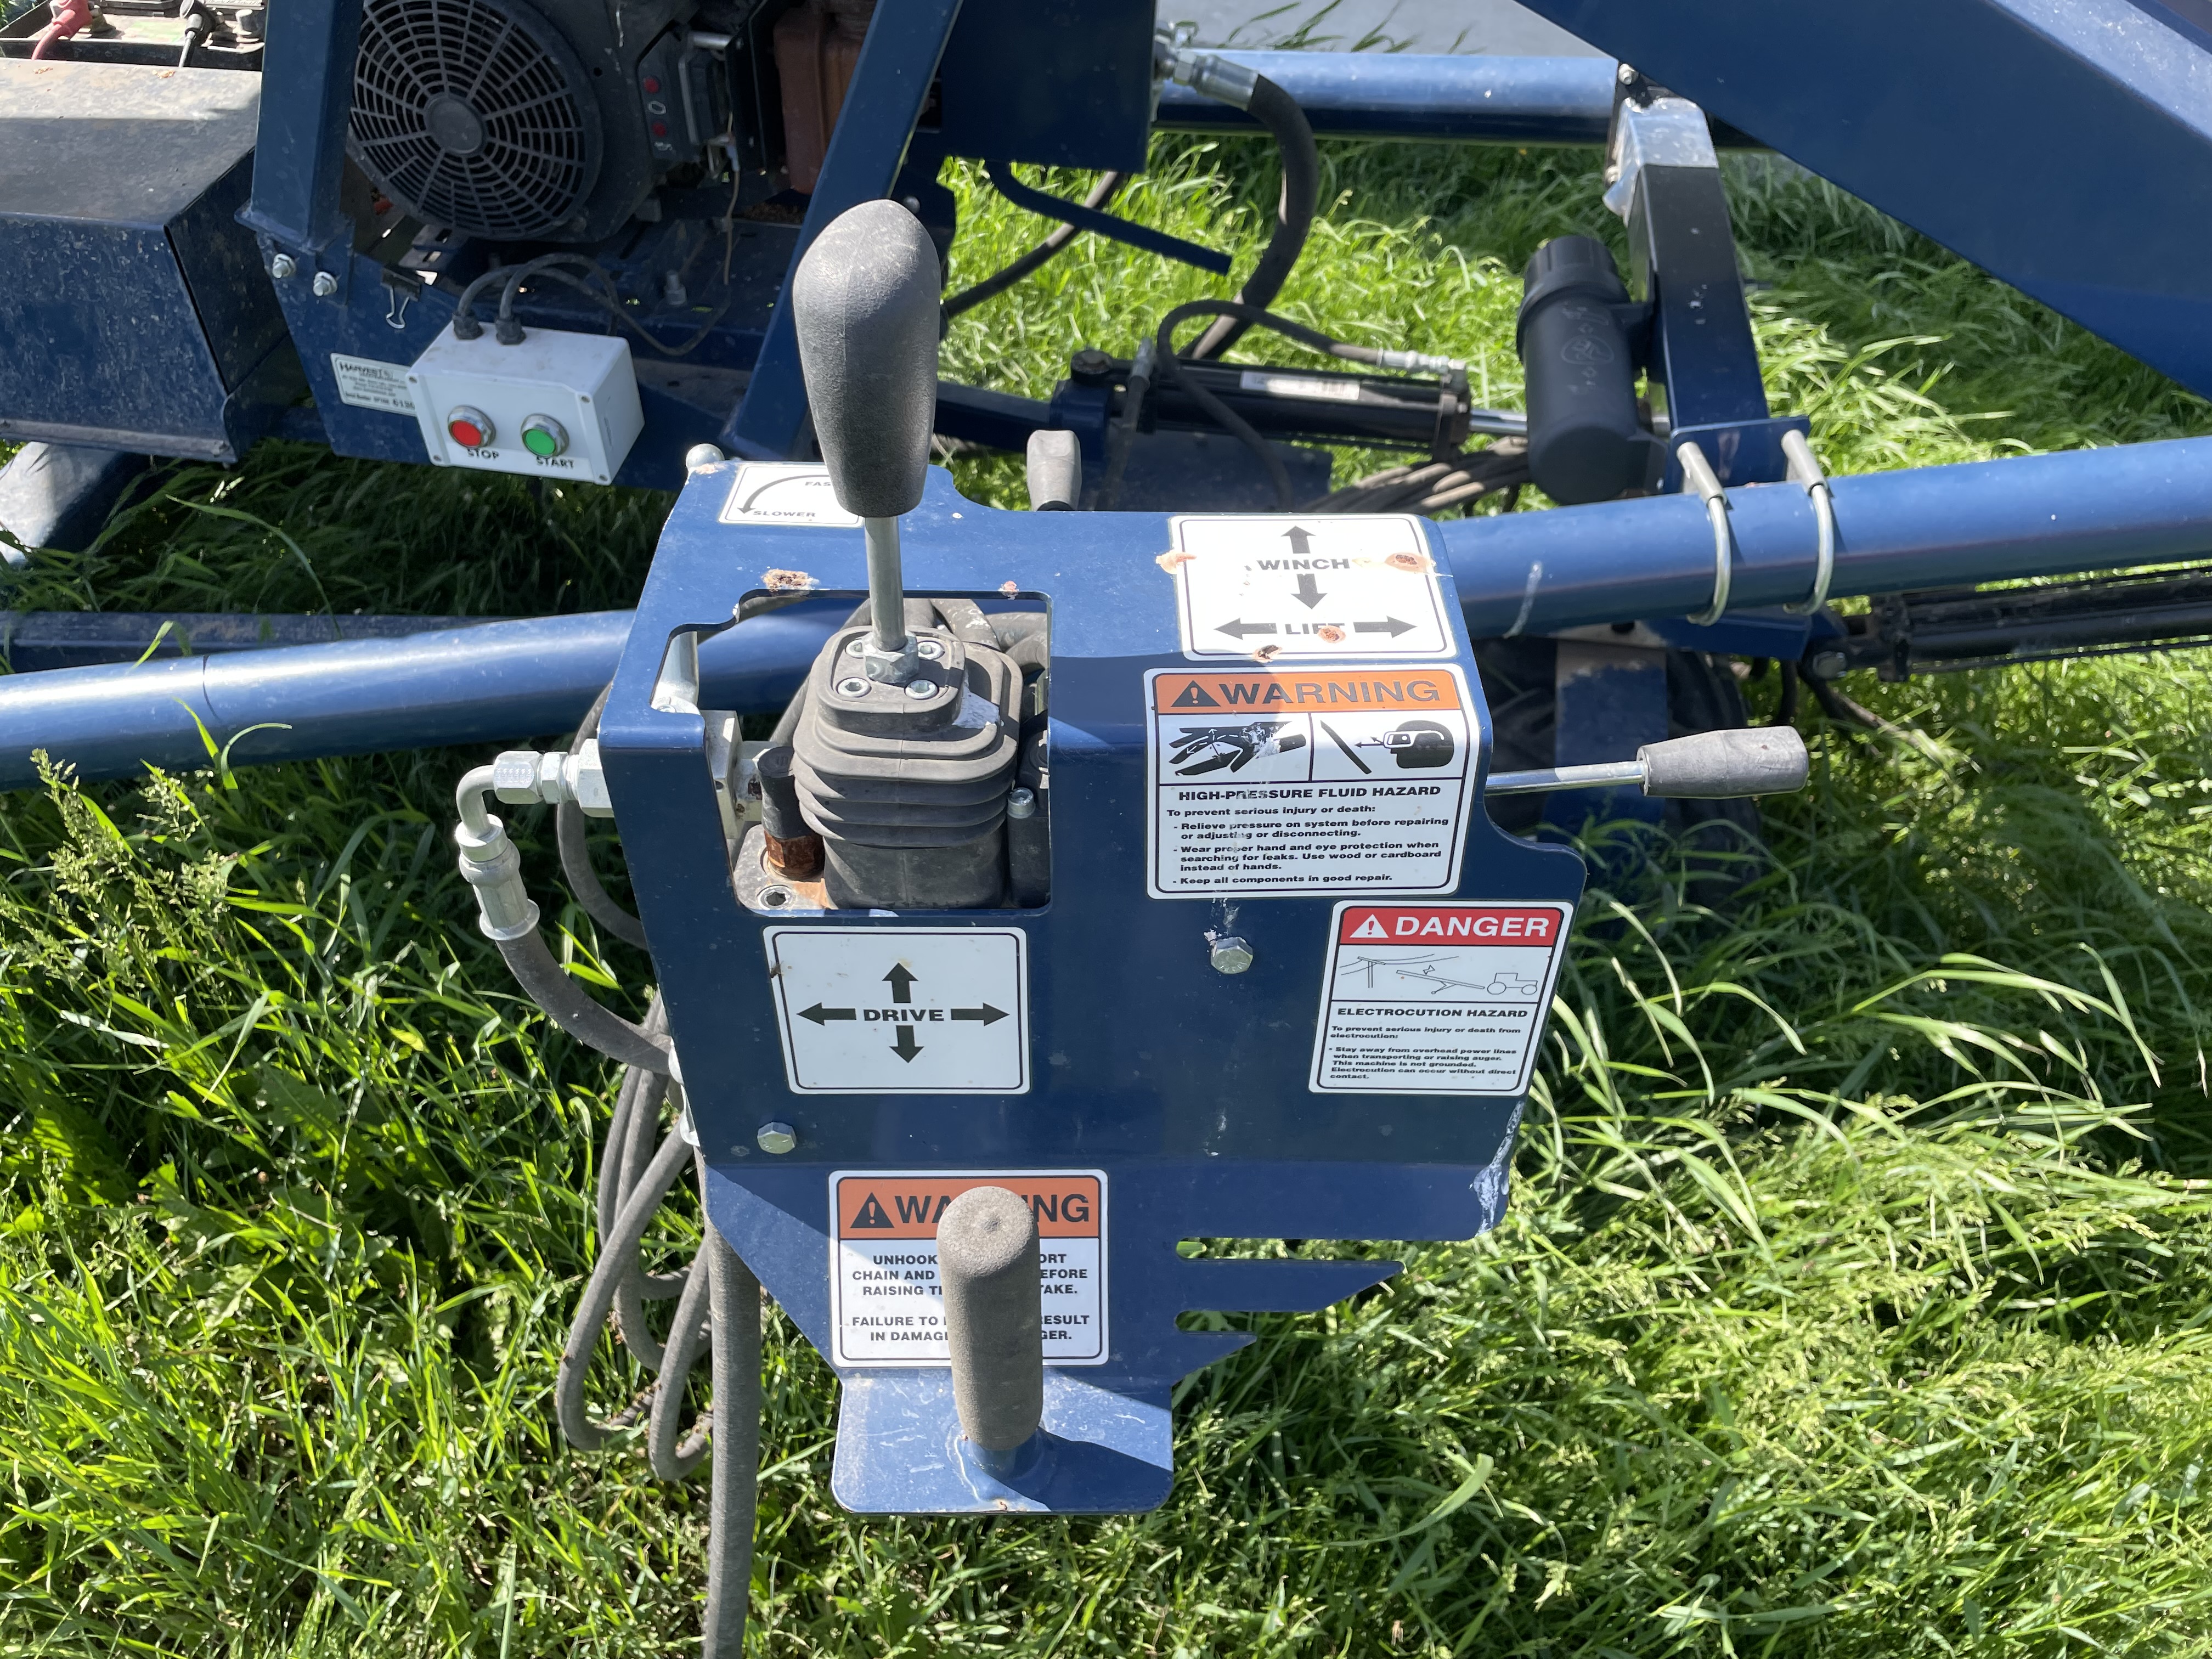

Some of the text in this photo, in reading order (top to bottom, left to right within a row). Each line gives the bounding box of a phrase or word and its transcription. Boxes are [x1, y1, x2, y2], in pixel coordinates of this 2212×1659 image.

[467, 448, 500, 460] STOP
[537, 456, 574, 469] START
[1256, 558, 1351, 570] WINCH
[1219, 680, 1441, 704] WARNING
[1318, 788, 1367, 797] FLUID
[1373, 787, 1441, 796] HAZARD
[1184, 809, 1230, 817] prevent
[1395, 818, 1448, 826] repairing
[1340, 842, 1402, 851] protection
[1395, 916, 1550, 937] DANGER
[864, 1009, 944, 1021] DRIVE
[895, 1194, 1088, 1222] WANG
[873, 1255, 938, 1265] UNHOOK
[852, 1269, 1087, 1280] CHAIN AND EFORE
[863, 1286, 923, 1295] RAISING
[852, 1317, 913, 1326] FAILURE
[919, 1317, 938, 1325] TO
[1041, 1315, 1090, 1324] ESULT
[871, 1332, 885, 1341] IN
